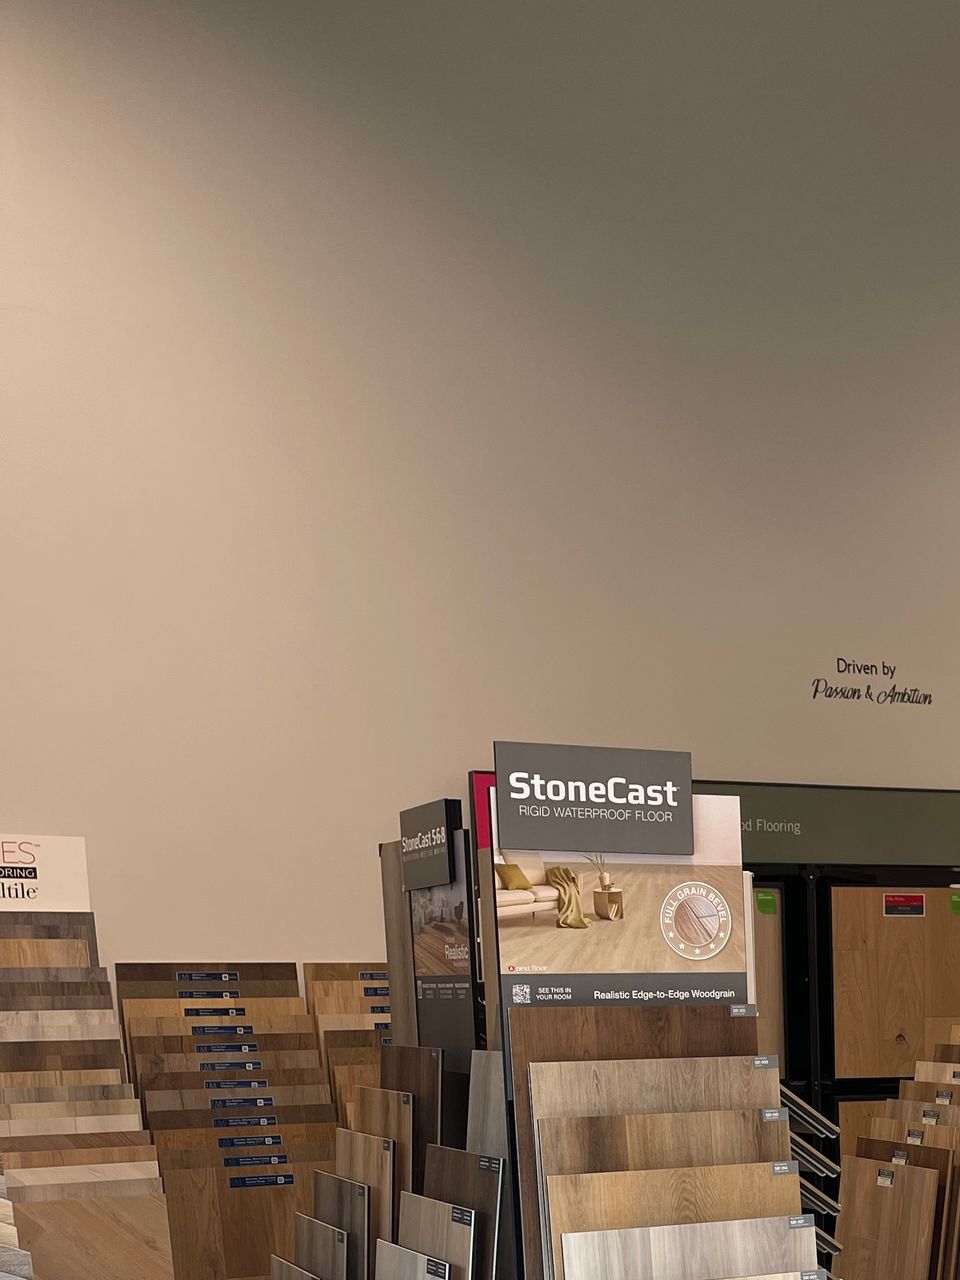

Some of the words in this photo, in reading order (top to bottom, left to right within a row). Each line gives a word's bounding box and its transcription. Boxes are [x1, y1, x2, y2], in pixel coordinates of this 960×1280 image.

[837, 657, 878, 675] Driven
[882, 661, 896, 679] by
[811, 678, 862, 700] Passion
[865, 684, 874, 702] &
[876, 684, 933, 705] Ambition
[508, 771, 679, 807] StoneCast
[519, 805, 550, 817] RIGID
[553, 806, 632, 821] WATERPROOF
[635, 810, 673, 823] FLOOR
[756, 818, 801, 835] Flooring
[402, 830, 432, 853] StoneCast
[664, 899, 678, 924] FULL
[676, 886, 707, 900] GRAIN
[707, 892, 727, 924] BEVEL
[445, 944, 469, 960] Realistic
[593, 989, 630, 1000] Realistic
[632, 989, 689, 1000] Edge-to-Edge
[691, 988, 735, 999] Woodgrain
